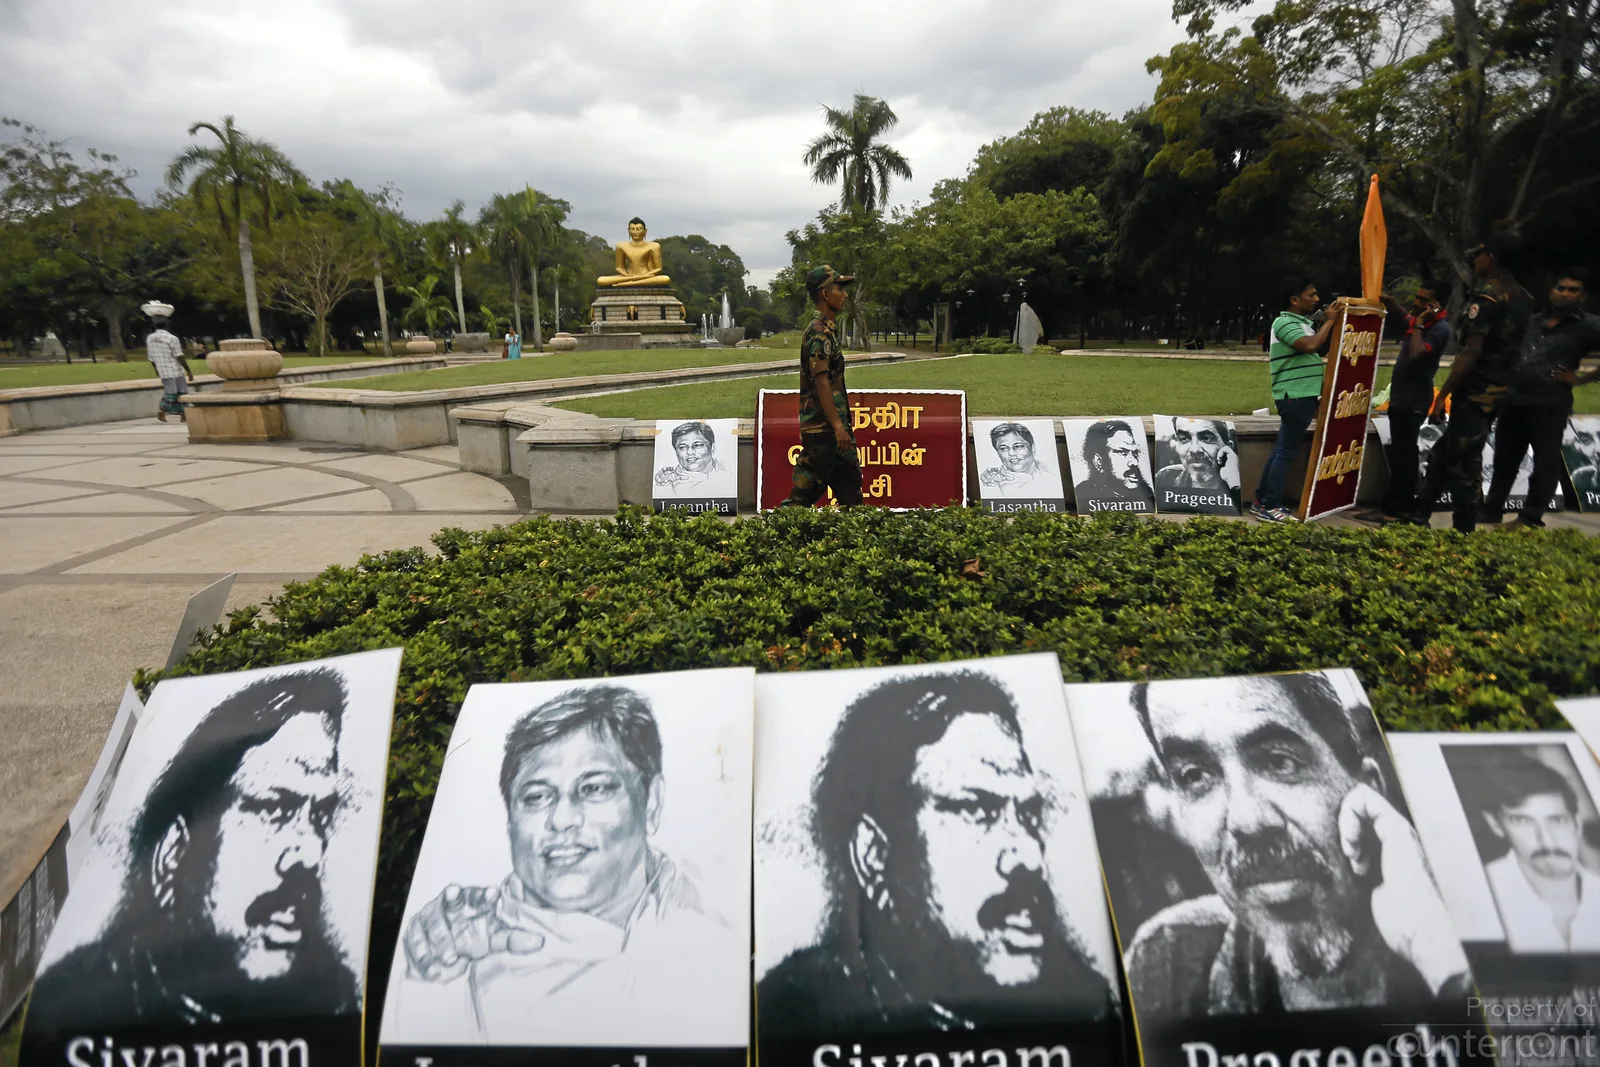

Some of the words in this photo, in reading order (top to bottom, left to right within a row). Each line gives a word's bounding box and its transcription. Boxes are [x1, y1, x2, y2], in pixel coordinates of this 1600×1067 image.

[1165, 491, 1233, 506] Prageeth
[990, 500, 1057, 513] Lasantha
[1089, 500, 1147, 512] Sivaram
